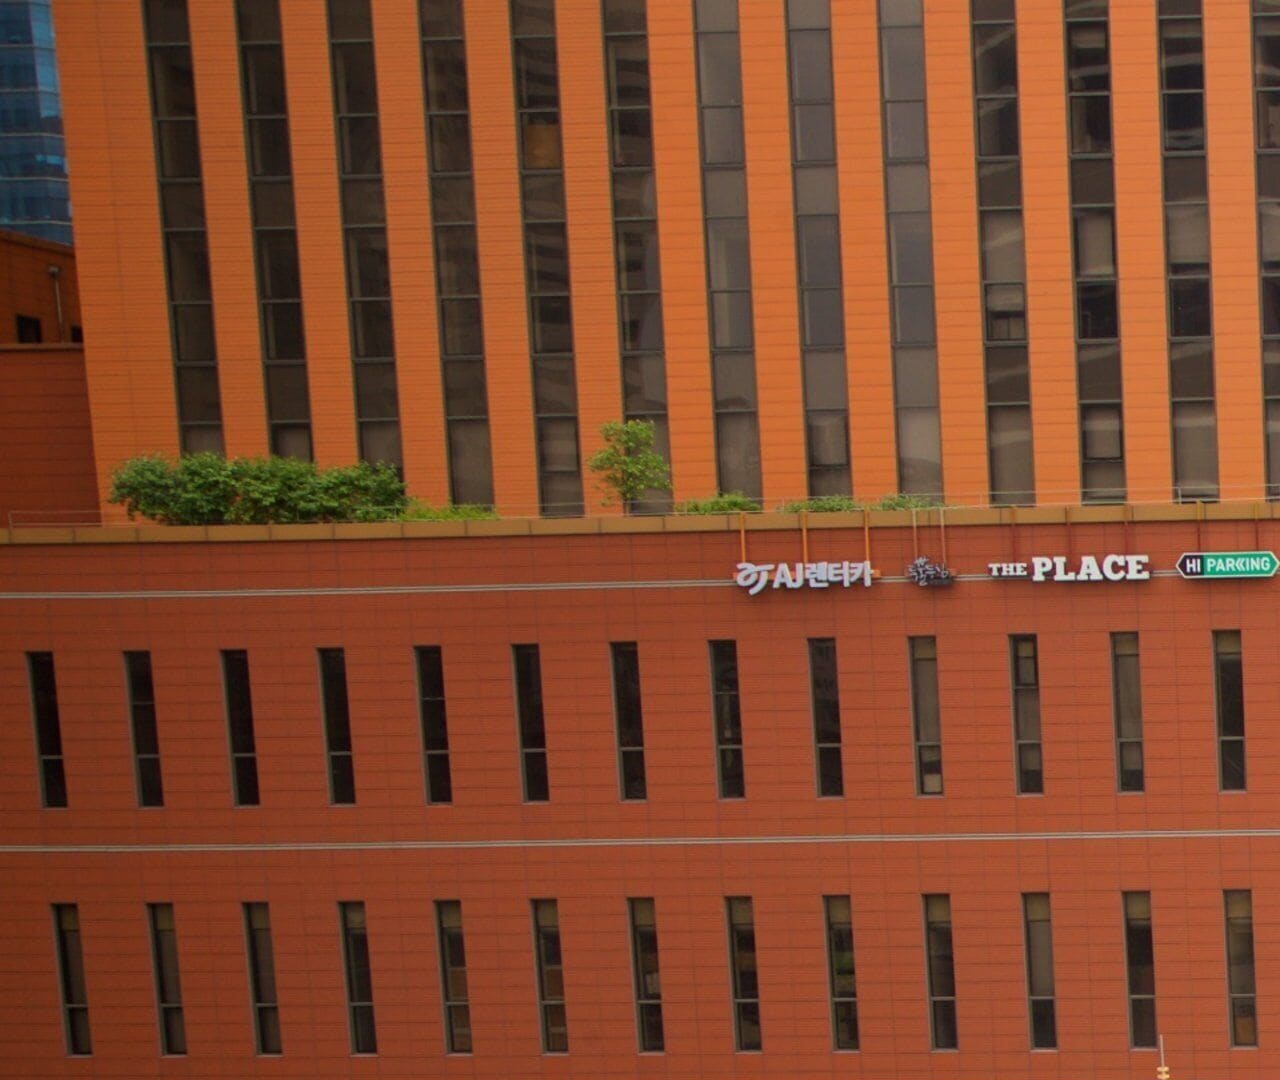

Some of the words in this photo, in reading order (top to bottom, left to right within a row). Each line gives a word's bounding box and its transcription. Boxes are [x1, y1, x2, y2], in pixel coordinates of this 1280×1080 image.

[989, 563, 1027, 577] THE
[1032, 554, 1150, 582] PLACE
[1186, 558, 1201, 573] HI
[1207, 556, 1271, 573] PARKING
